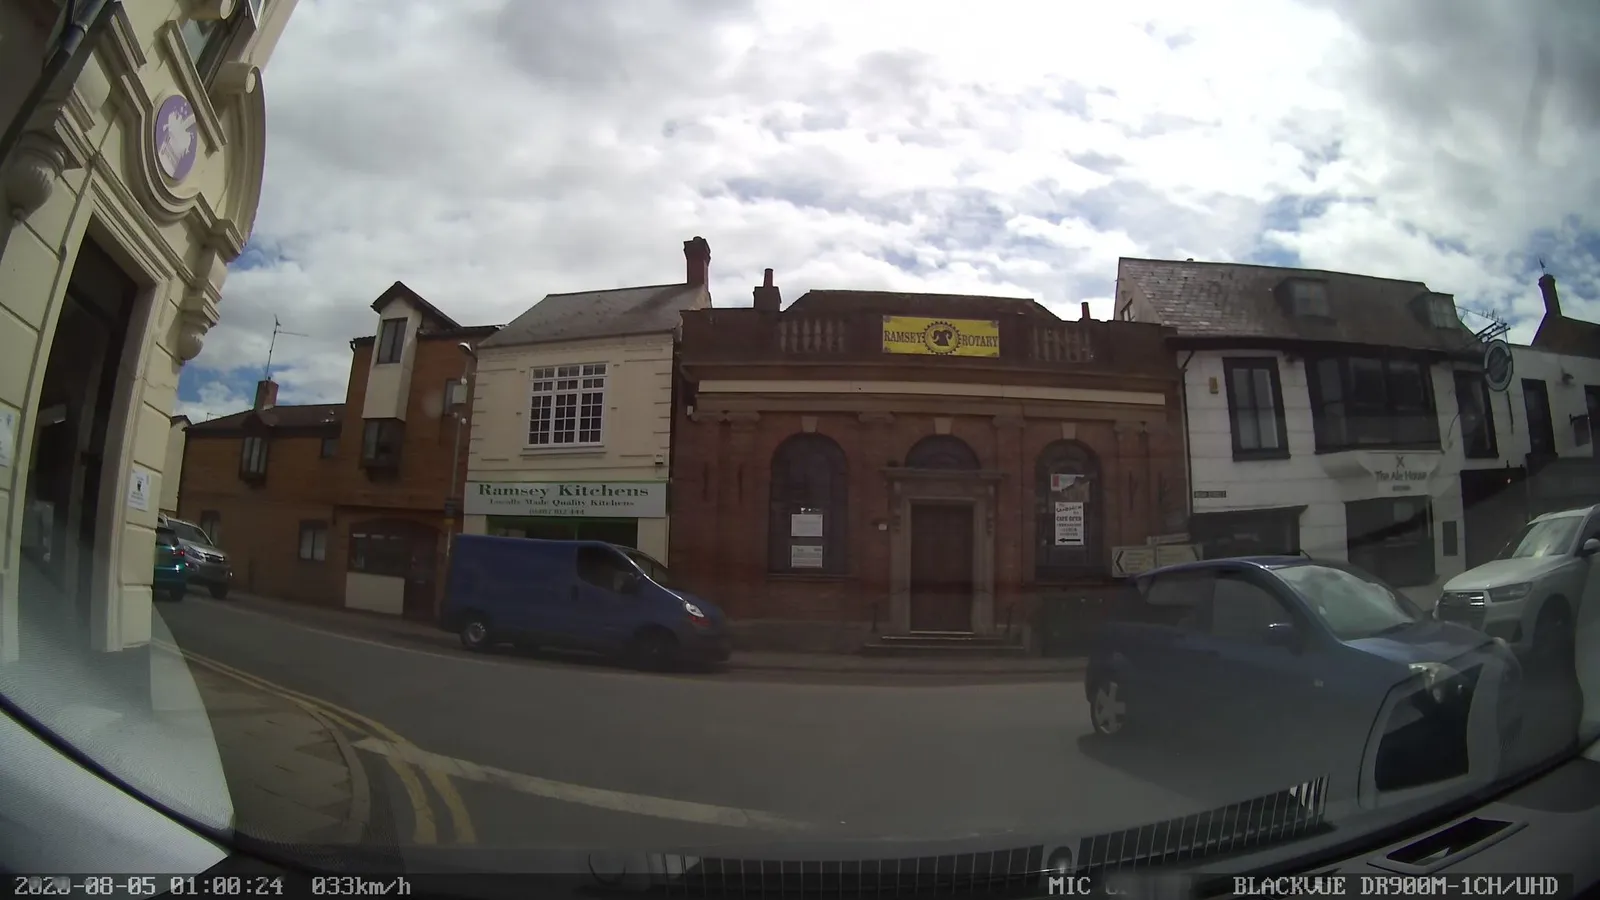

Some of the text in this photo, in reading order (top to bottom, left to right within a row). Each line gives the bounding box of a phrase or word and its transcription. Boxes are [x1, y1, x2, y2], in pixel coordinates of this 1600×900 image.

[884, 330, 924, 344] RAMSEY
[962, 334, 999, 347] ROTARY
[1375, 469, 1427, 481] The Ale House
[479, 484, 649, 499] Ramsey Kitchens
[552, 499, 586, 507] Quality
